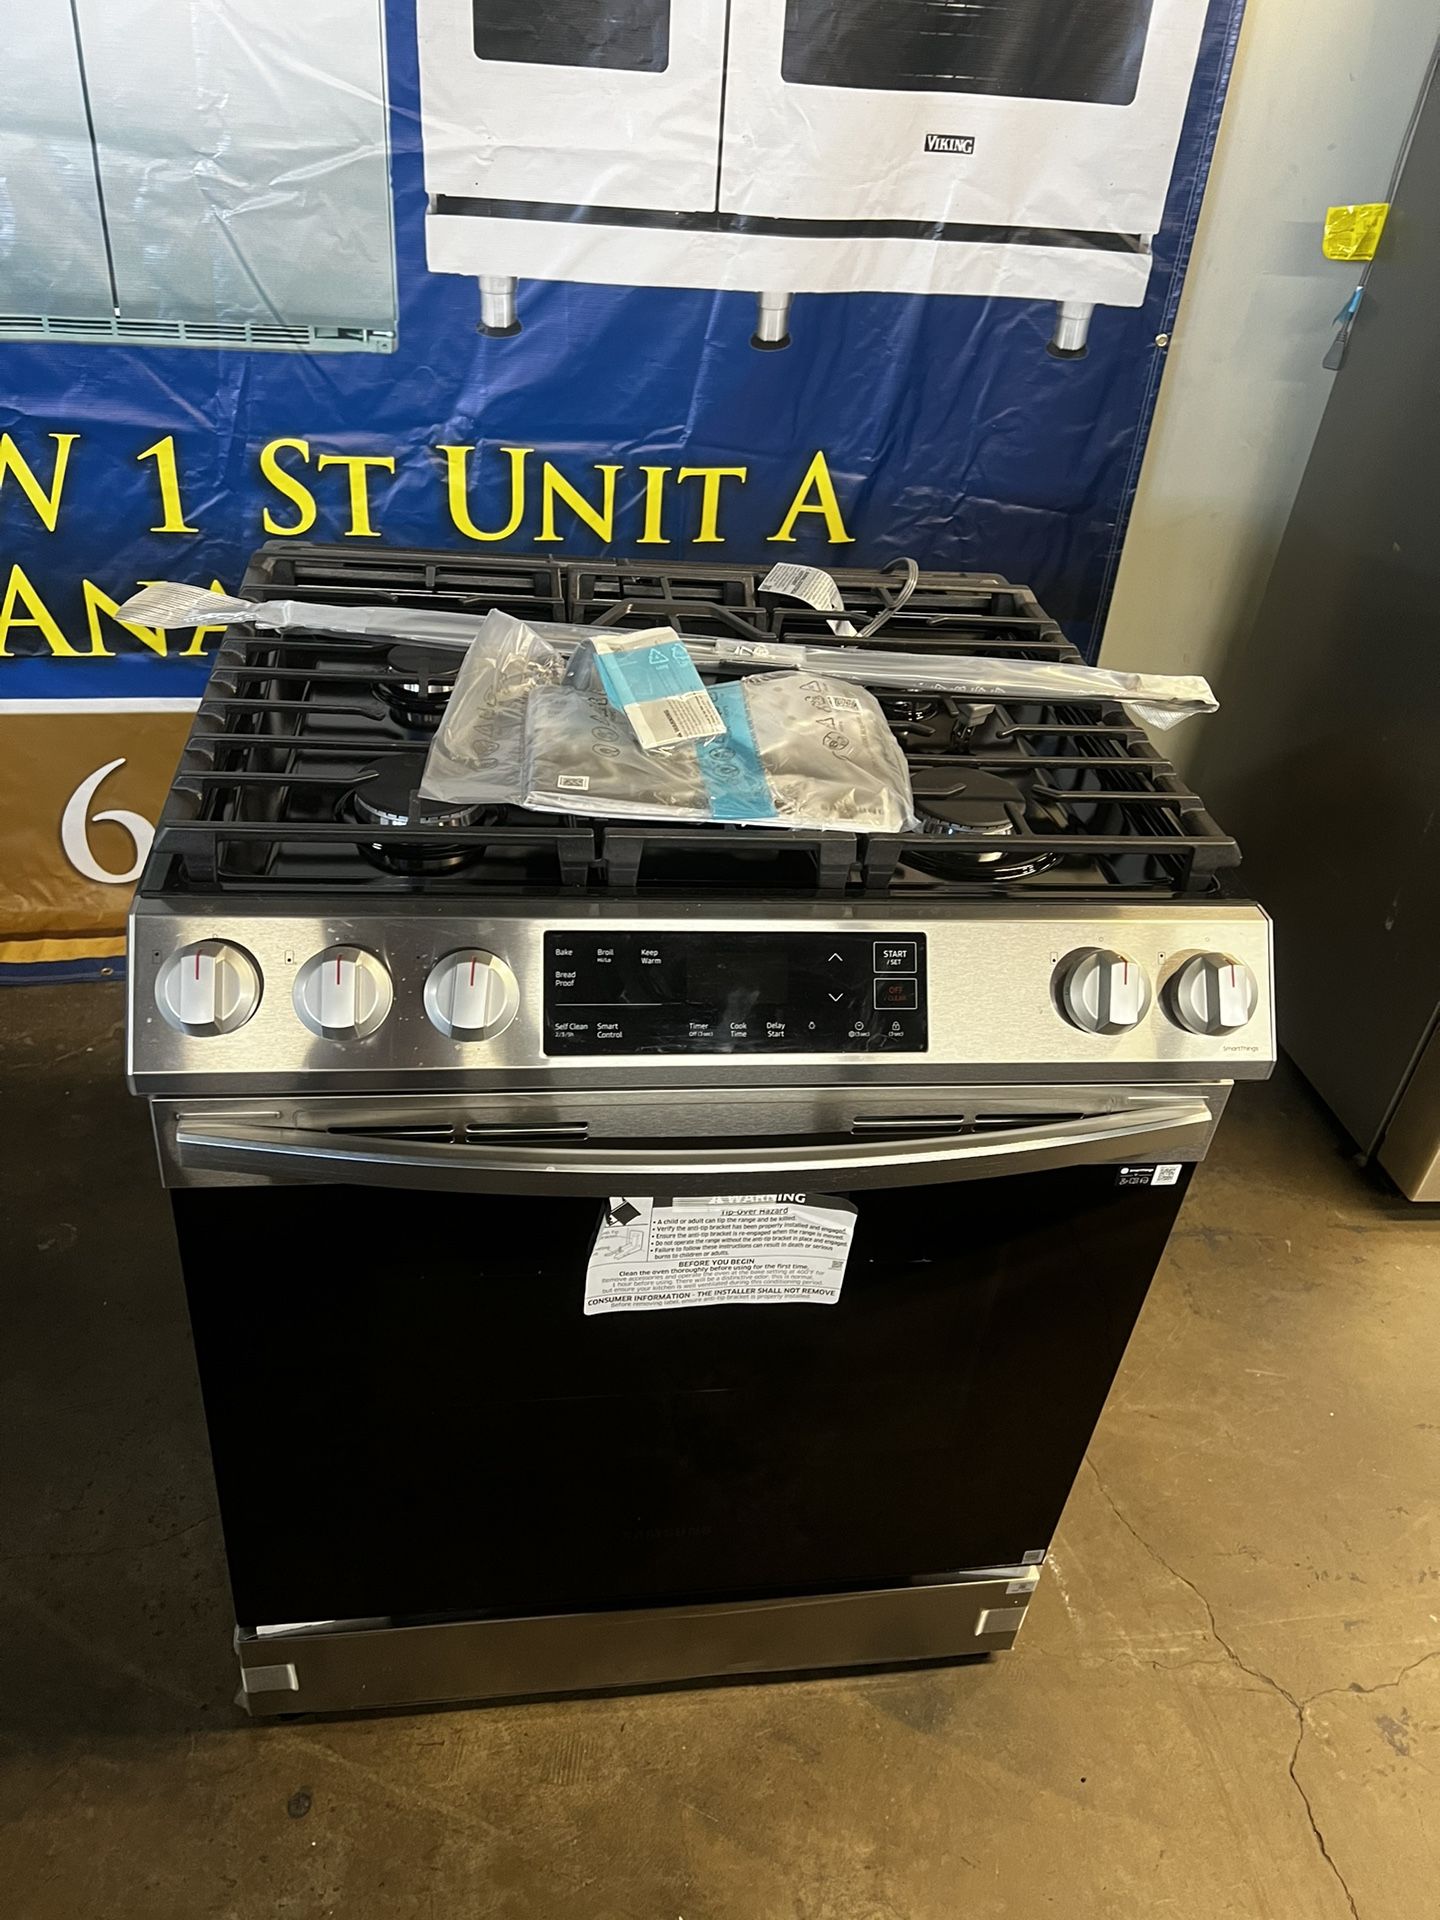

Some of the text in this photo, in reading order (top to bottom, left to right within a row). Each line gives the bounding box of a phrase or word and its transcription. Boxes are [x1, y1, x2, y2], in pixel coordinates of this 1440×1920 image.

[927, 135, 973, 153] VIKING
[138, 435, 199, 532] 1
[435, 444, 748, 542] UNIT
[766, 450, 856, 542] A
[61, 758, 156, 884] 6
[641, 949, 659, 957] Keep
[883, 950, 907, 958] START
[689, 1022, 709, 1030] Timer
[730, 1022, 747, 1030] Cook
[766, 1022, 786, 1031] Delay
[731, 1030, 747, 1038] Time
[767, 1030, 785, 1038] Start
[721, 1207, 789, 1217] Tip-Over Hazard
[670, 1267, 708, 1275] thoroughly
[587, 1295, 632, 1306] CONSUMER
[634, 1292, 690, 1301] INFORMATION
[714, 1288, 756, 1296] INSTALLER
[802, 1287, 835, 1297] REMOVE
